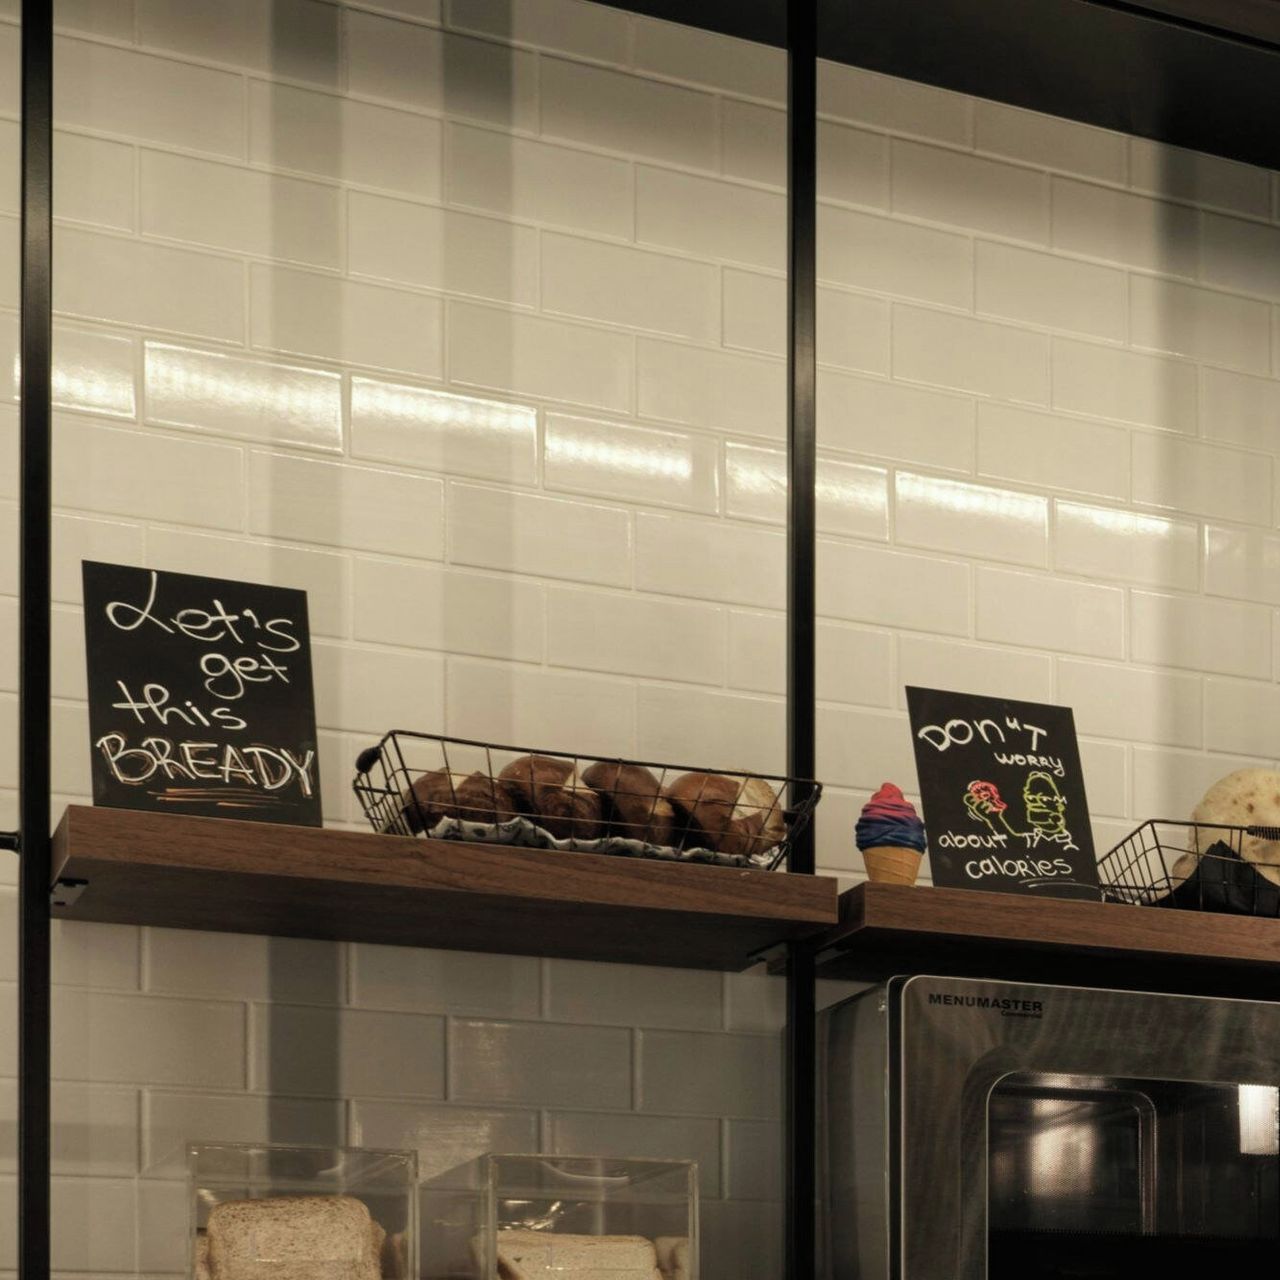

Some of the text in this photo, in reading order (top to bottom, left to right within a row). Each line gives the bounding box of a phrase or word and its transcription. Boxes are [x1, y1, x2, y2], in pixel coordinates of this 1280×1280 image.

[106, 571, 300, 652] Let's
[201, 653, 290, 699] get
[112, 680, 248, 730] this
[96, 732, 315, 797] BREADY
[938, 830, 1008, 850] about
[928, 993, 1043, 1012] MENUMASTER
